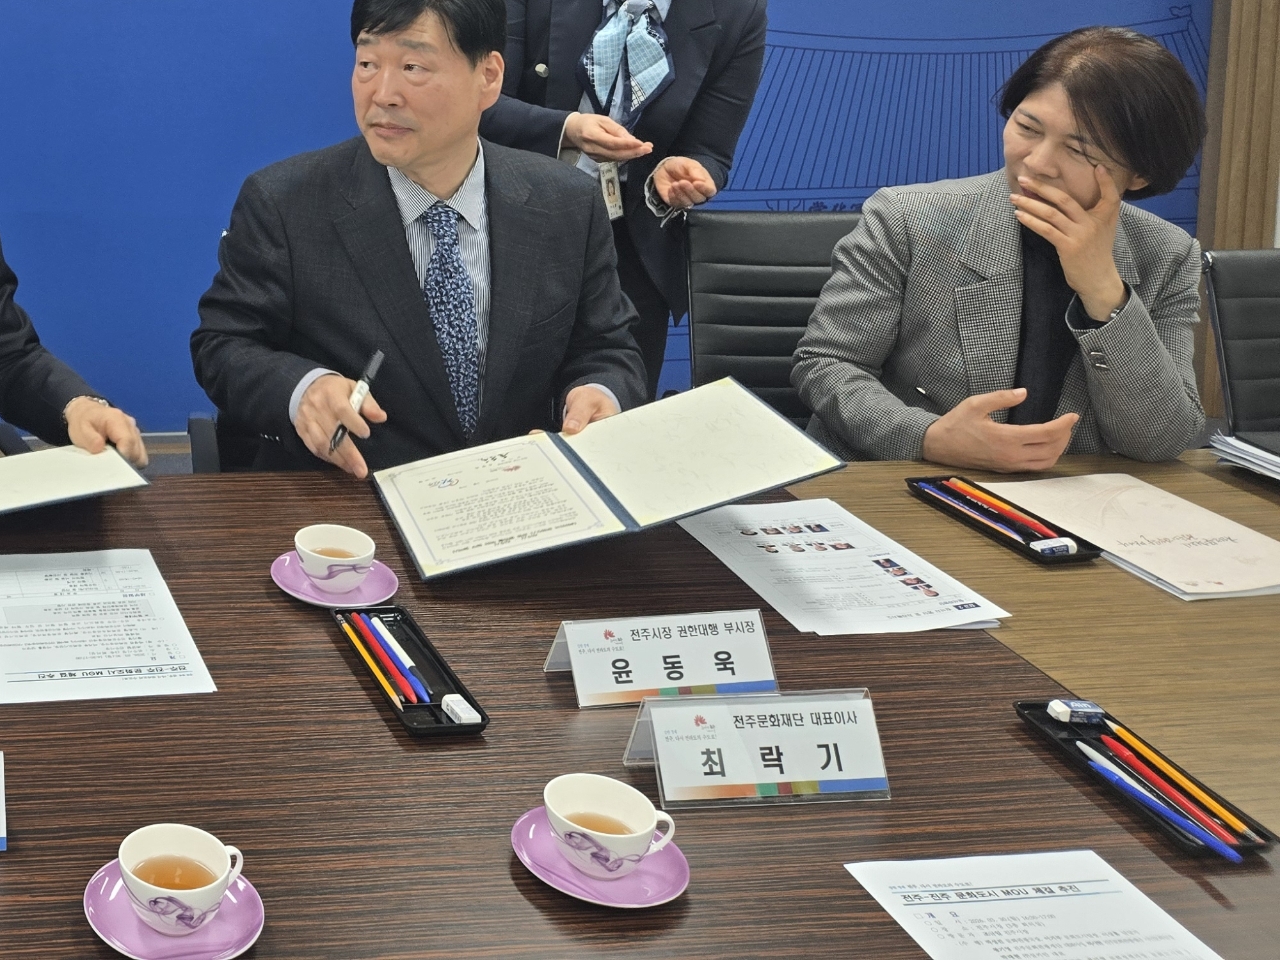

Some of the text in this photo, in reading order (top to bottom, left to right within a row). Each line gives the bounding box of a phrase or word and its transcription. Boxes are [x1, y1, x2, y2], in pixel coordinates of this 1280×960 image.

[629, 626, 673, 642] 전주시장
[676, 623, 720, 638] 권한대행
[723, 620, 756, 635] 부시장
[732, 712, 805, 729] 전주문화재단
[809, 710, 858, 726] 대표이사
[954, 889, 1000, 900] 문화도시
[1001, 888, 1029, 897] MOU
[1058, 884, 1081, 893] 추진
